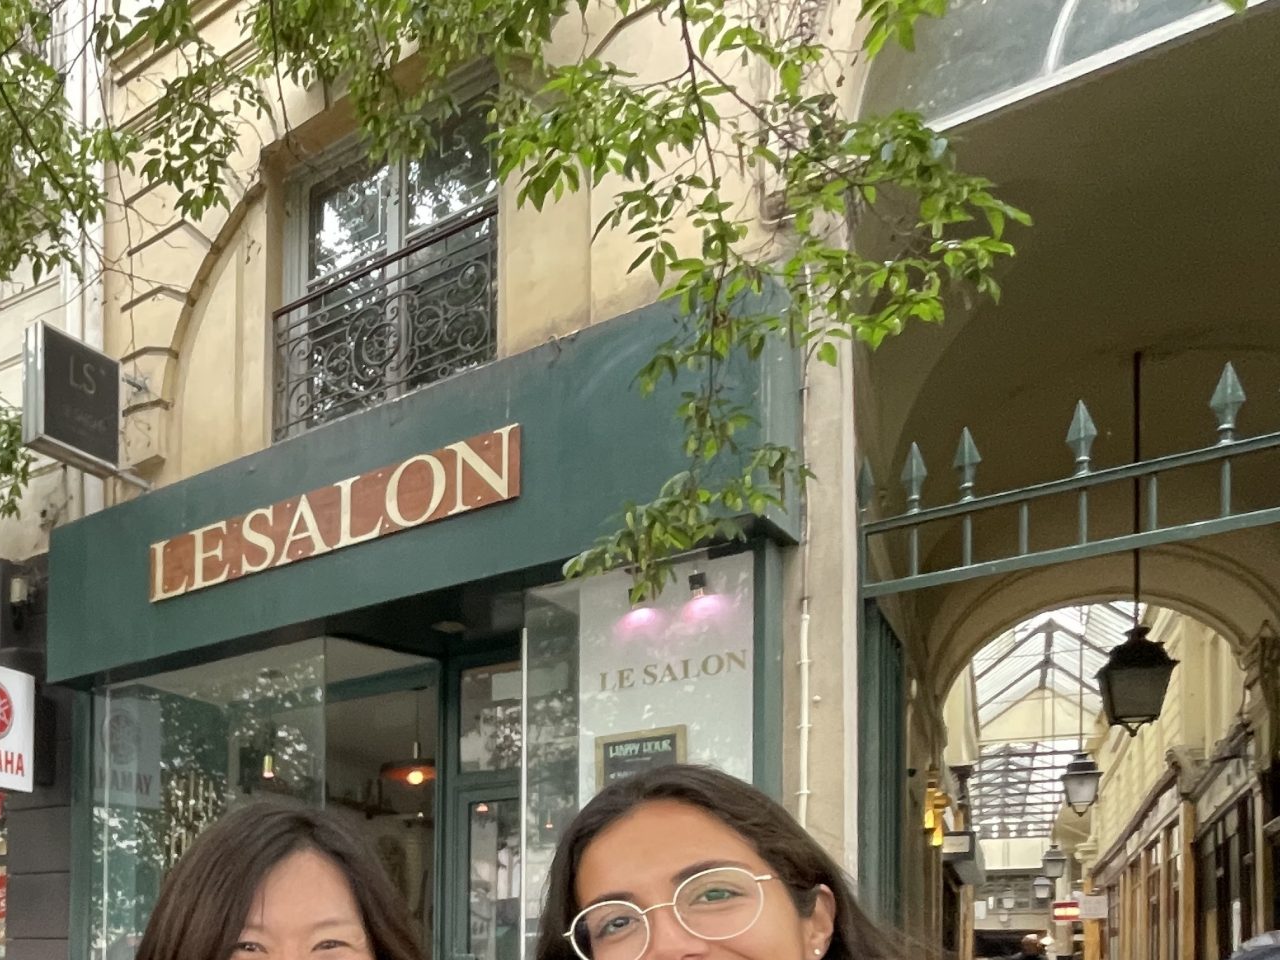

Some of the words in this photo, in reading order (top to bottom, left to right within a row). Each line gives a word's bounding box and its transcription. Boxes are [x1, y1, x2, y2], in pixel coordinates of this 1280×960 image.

[600, 668, 635, 692] LE
[642, 650, 746, 686] SALON
[642, 739, 672, 753] HOUR
